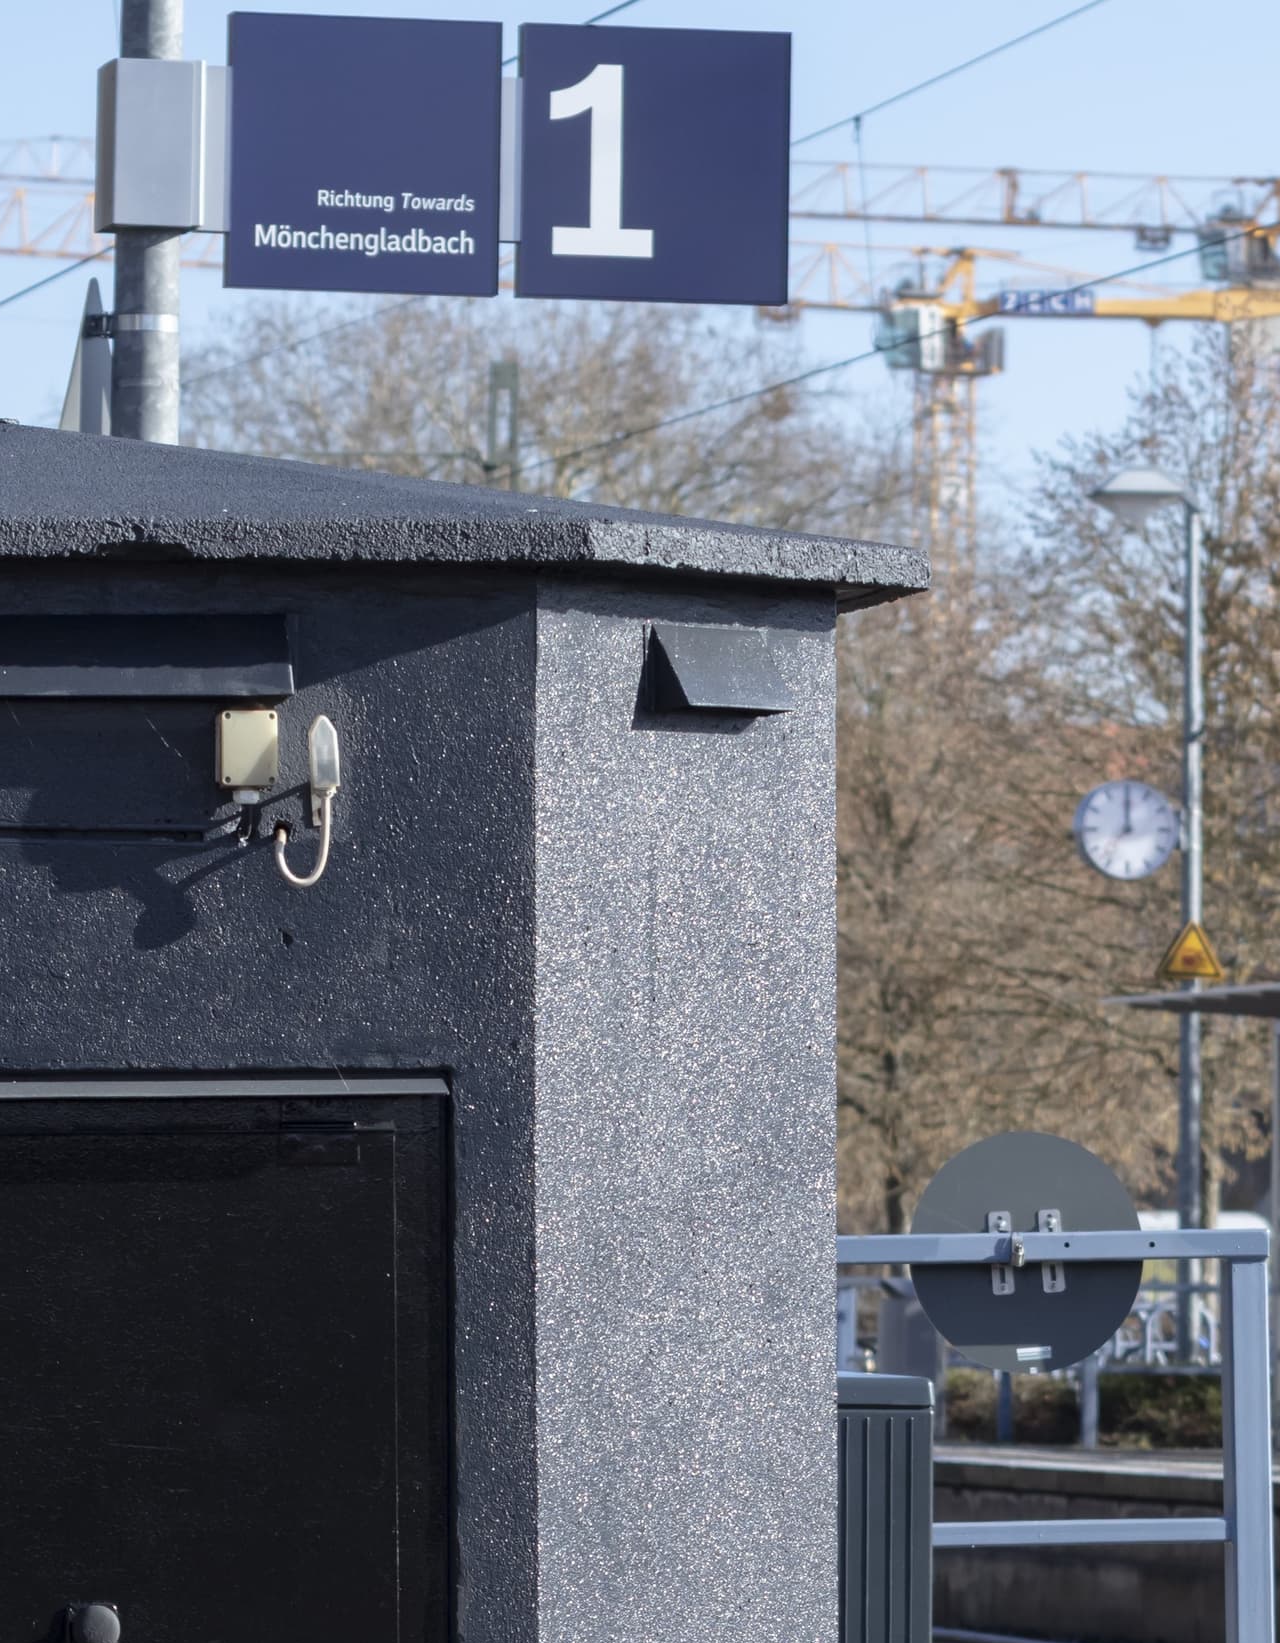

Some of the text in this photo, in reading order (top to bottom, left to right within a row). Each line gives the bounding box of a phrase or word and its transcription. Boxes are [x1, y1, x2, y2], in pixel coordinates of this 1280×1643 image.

[549, 63, 654, 259] 1
[317, 189, 476, 213] Richtung Towards
[254, 223, 475, 257] Mönchengladbach
